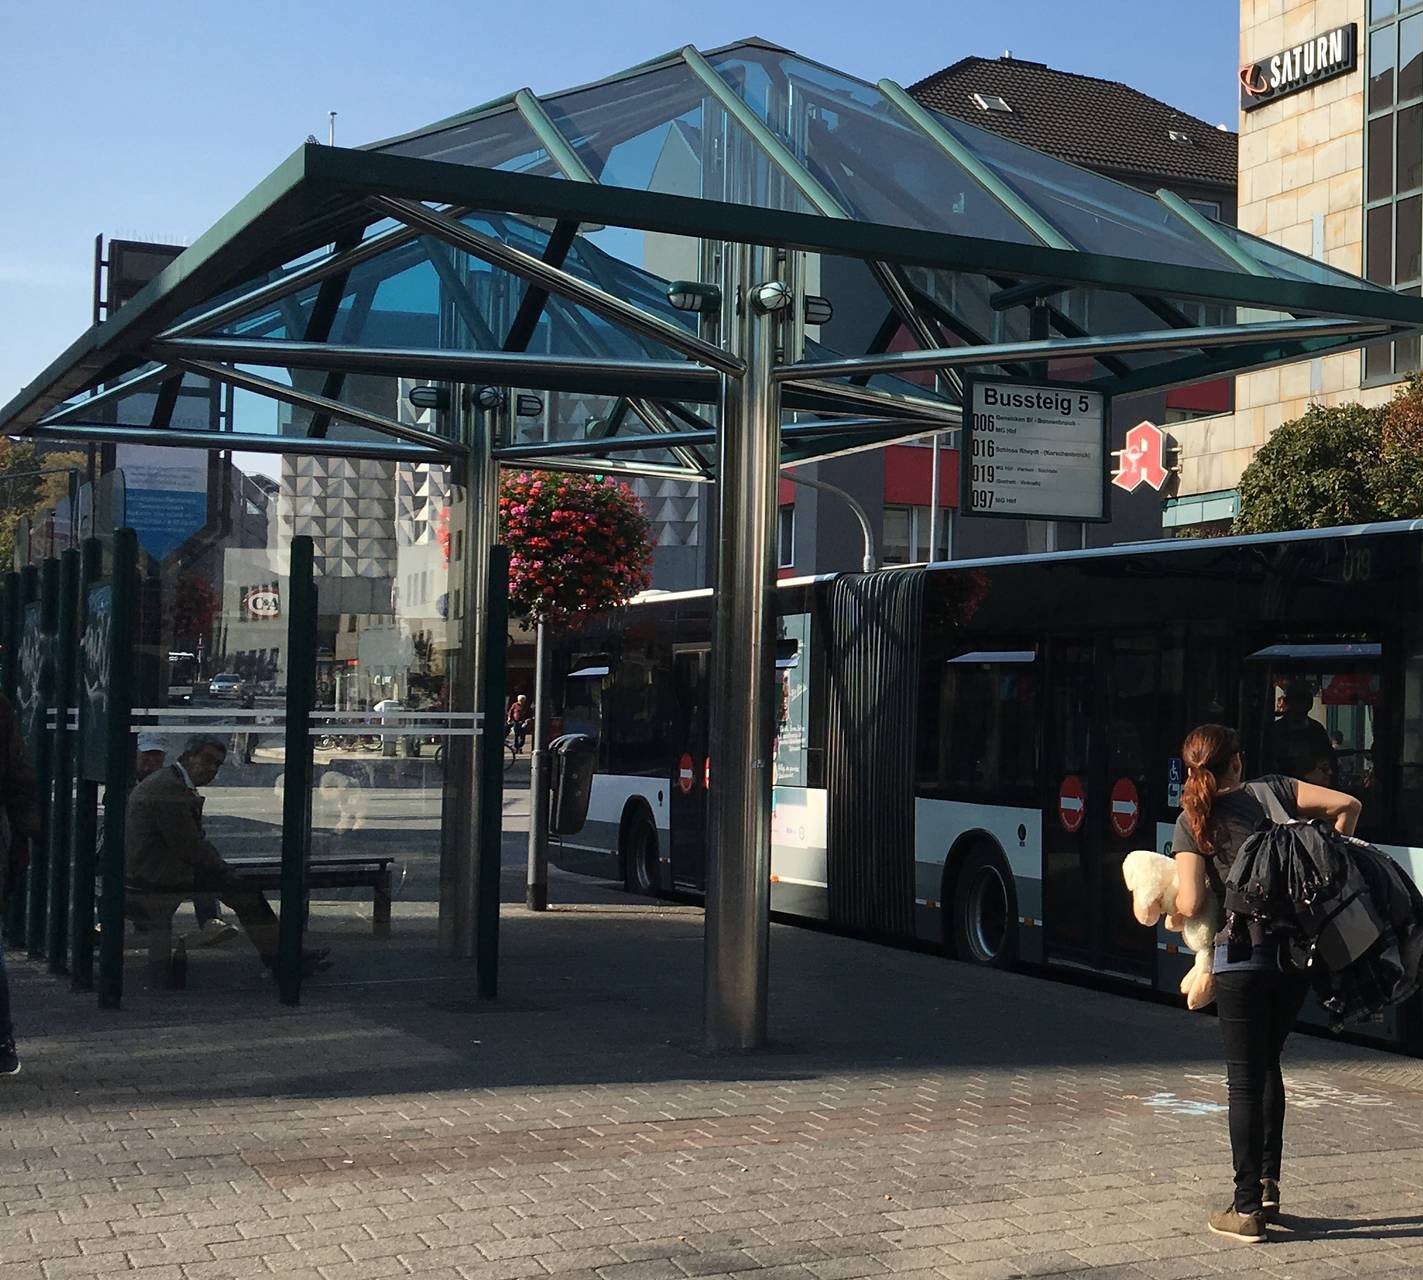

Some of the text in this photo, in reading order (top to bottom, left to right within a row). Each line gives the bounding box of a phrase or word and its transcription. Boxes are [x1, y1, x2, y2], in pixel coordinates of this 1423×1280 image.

[1269, 29, 1343, 89] SATURN
[984, 387, 1089, 416] Bussteig 5
[972, 413, 995, 432] 006
[972, 438, 995, 457] 016
[972, 464, 995, 483] 019
[971, 489, 995, 509] 097
